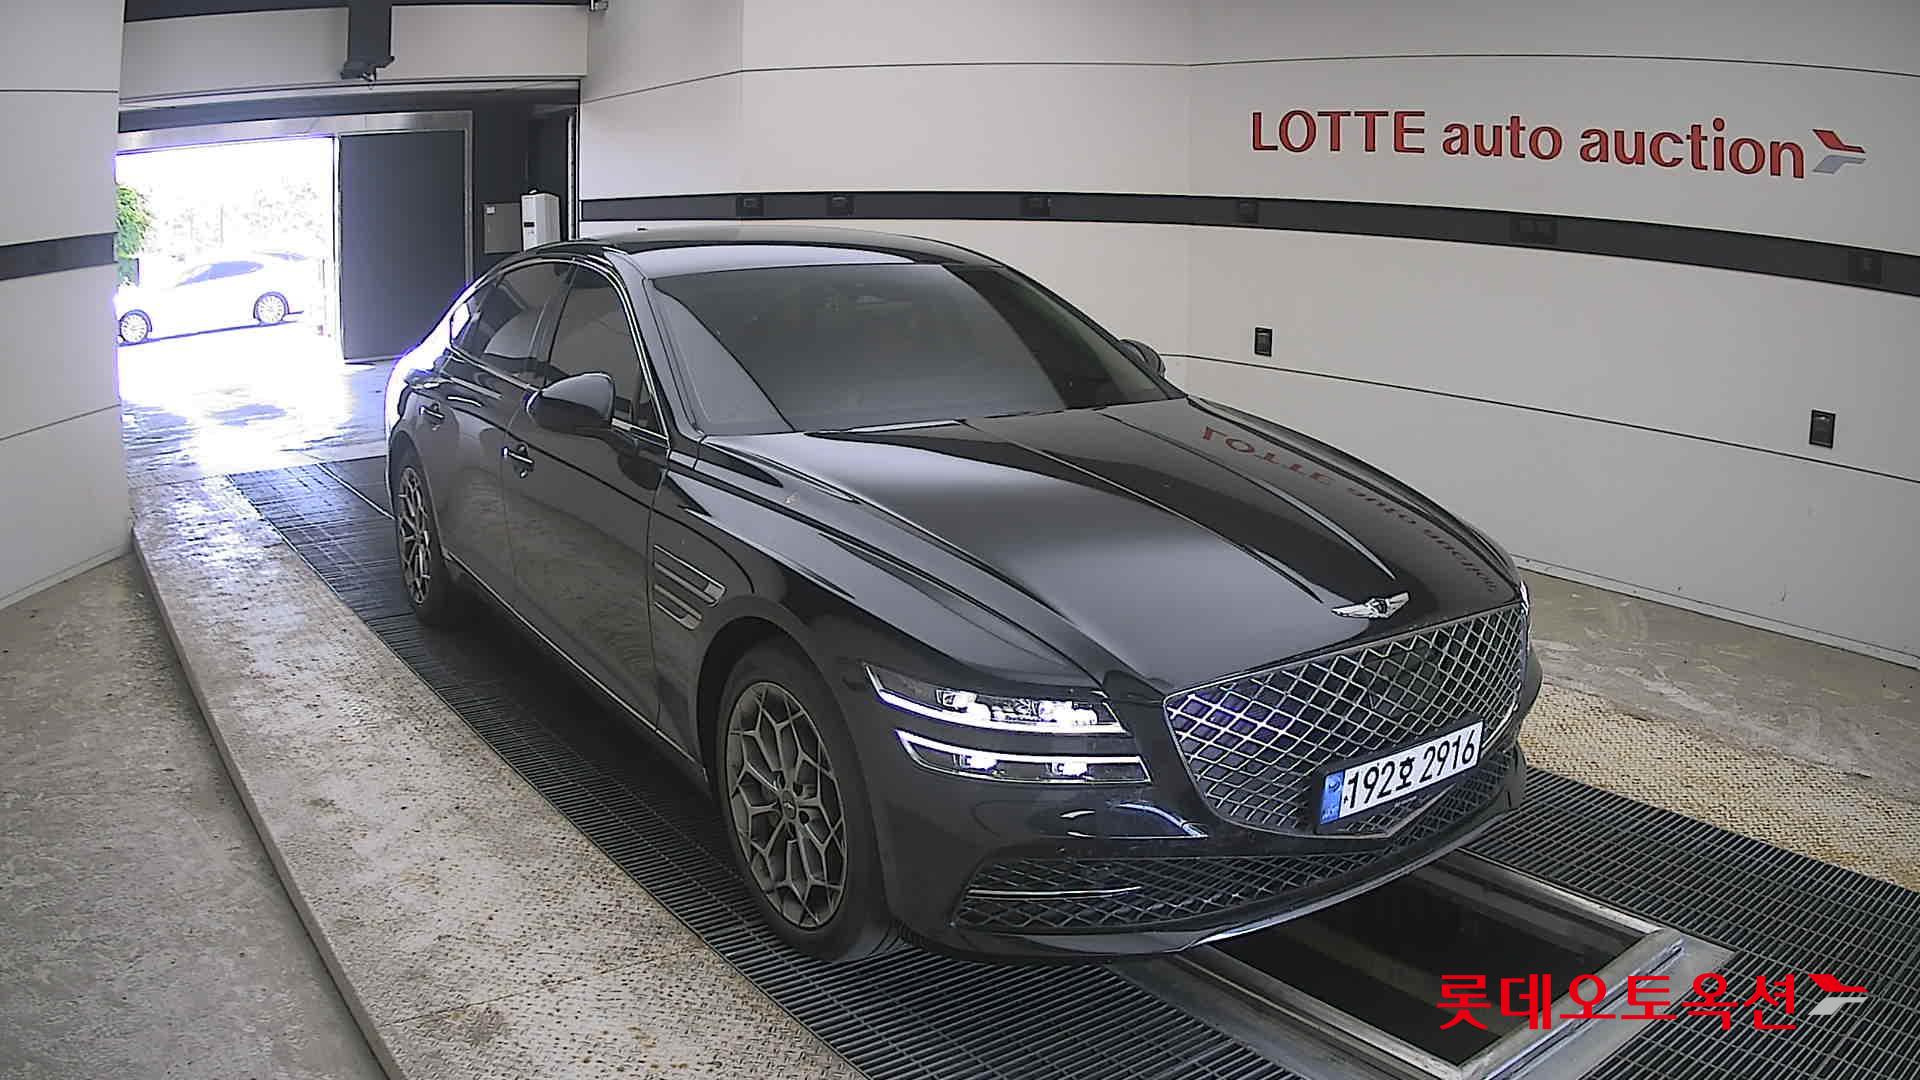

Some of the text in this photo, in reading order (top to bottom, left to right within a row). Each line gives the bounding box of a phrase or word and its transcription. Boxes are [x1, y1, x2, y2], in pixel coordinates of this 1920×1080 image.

[1252, 110, 1804, 179] LOTTE auto auction
[1347, 729, 1475, 809] 192호 2916
